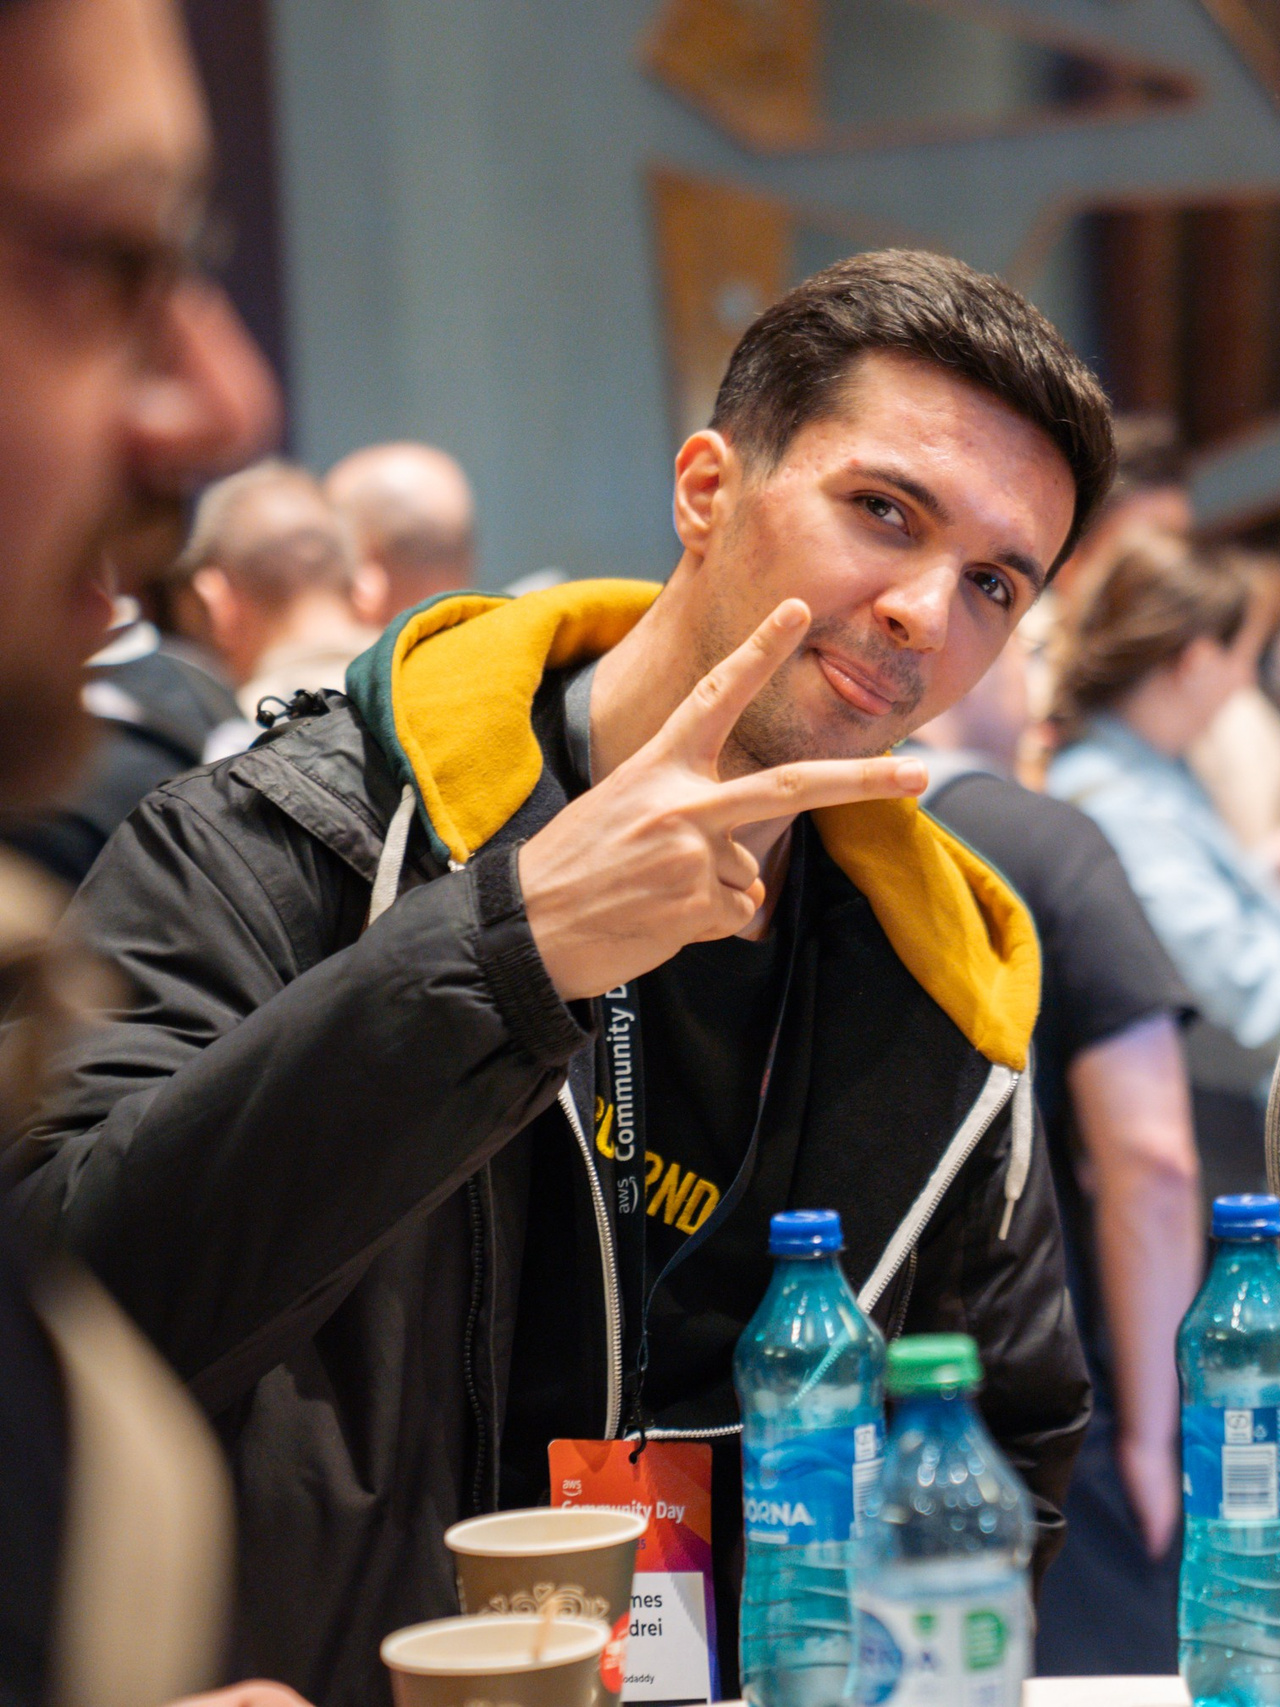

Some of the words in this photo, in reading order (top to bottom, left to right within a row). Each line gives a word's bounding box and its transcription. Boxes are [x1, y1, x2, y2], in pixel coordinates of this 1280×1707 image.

[606, 1007, 635, 1162] Community
[617, 1178, 631, 1214] aws
[562, 1479, 582, 1491] aws
[656, 1501, 686, 1524] Day
[742, 1497, 817, 1527] ORNA
[630, 1594, 663, 1609] mes
[629, 1617, 663, 1637] drei
[622, 1673, 655, 1685] odaddy
